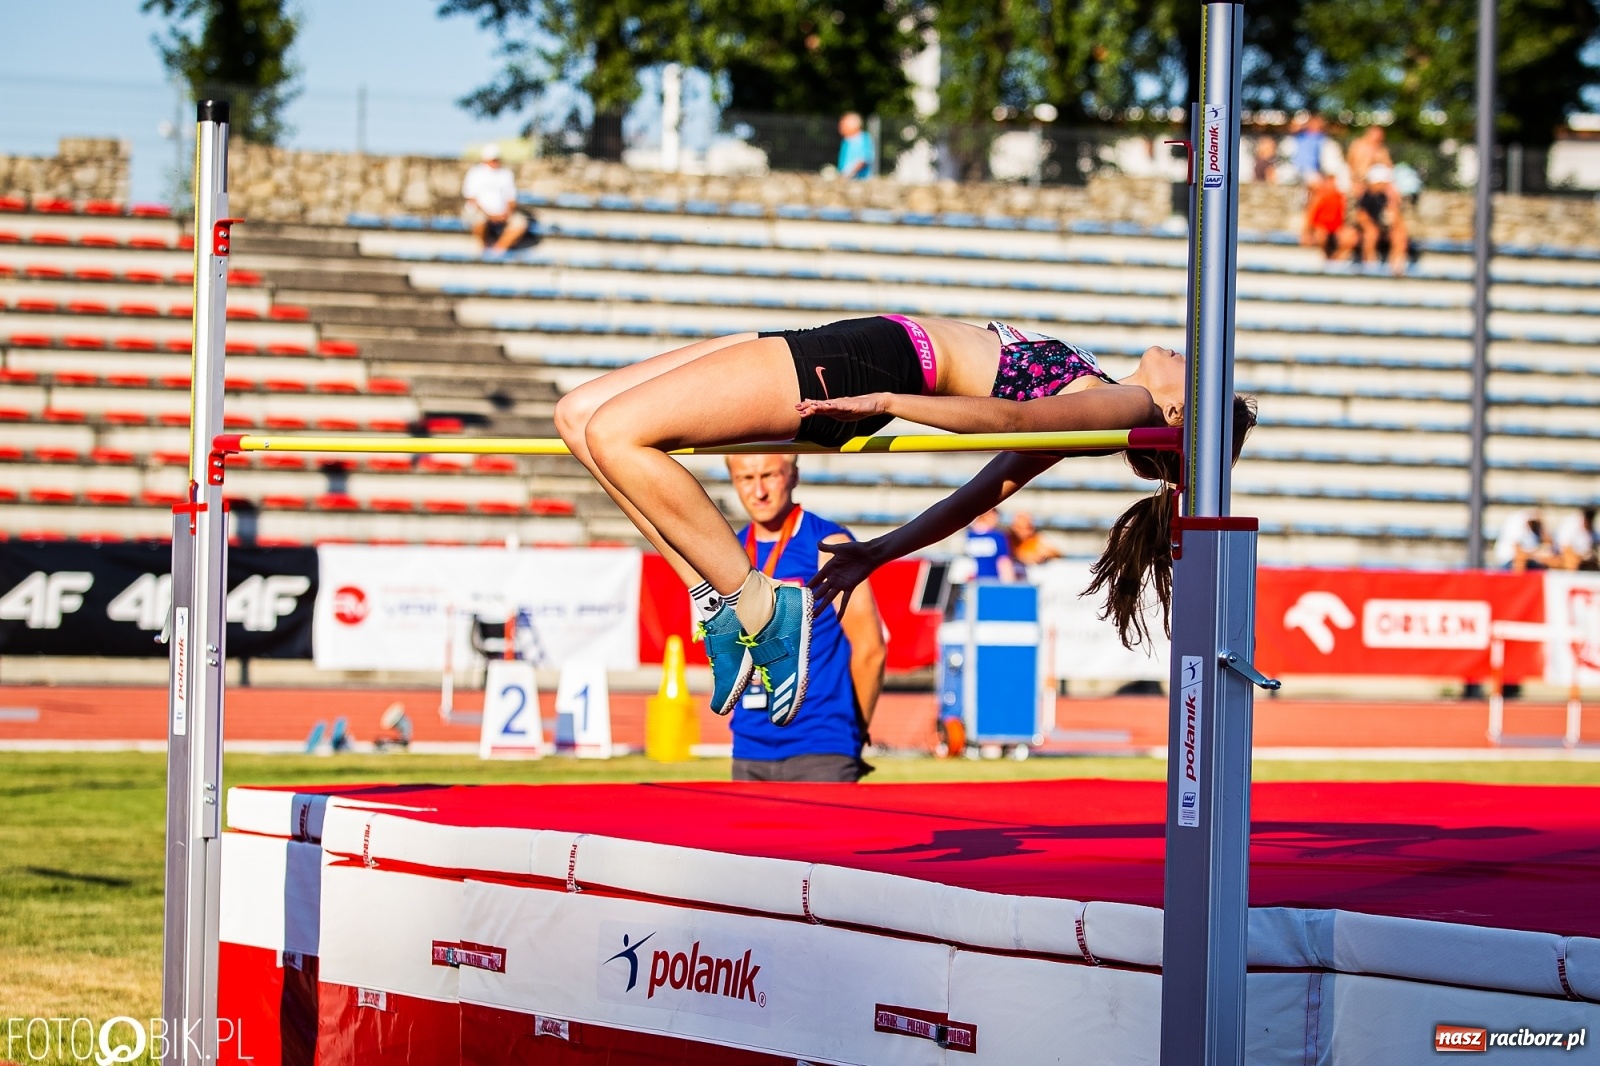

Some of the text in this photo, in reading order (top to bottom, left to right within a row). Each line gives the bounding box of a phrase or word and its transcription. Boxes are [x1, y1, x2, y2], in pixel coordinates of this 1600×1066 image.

[1208, 125, 1221, 173] polanik
[916, 339, 933, 370] PRO
[0, 570, 95, 630] 4F
[227, 573, 312, 632] 4F
[1376, 613, 1477, 637] ORLEN
[501, 684, 527, 735] 2
[573, 685, 590, 732] 1
[1184, 692, 1197, 782] polanik
[647, 940, 762, 1003] polanik
